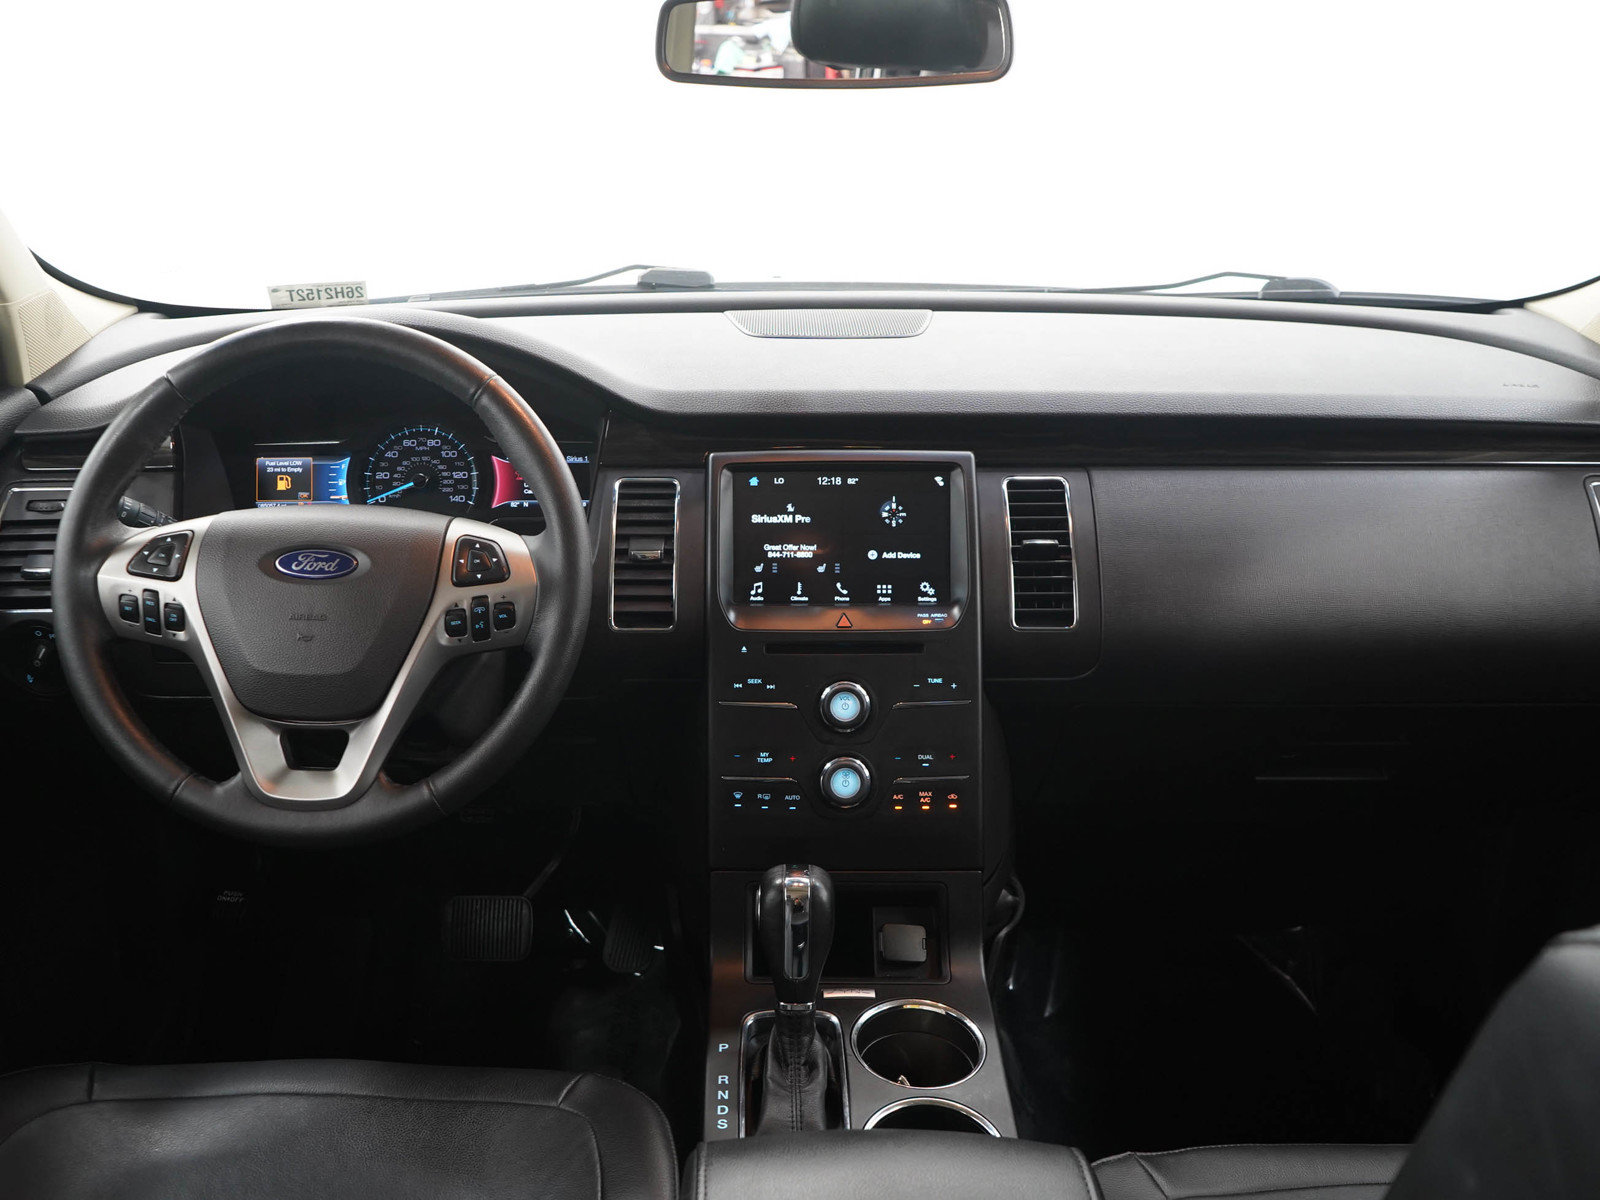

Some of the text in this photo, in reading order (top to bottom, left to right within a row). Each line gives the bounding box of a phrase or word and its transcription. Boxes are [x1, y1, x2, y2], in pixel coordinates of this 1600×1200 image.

[403, 439, 417, 447] 60
[427, 439, 441, 447] 80
[385, 450, 399, 458] 40
[441, 450, 458, 458] 100
[452, 471, 468, 479] 120
[773, 477, 785, 485] LO
[817, 476, 842, 486] 12:18
[449, 495, 466, 503] 140
[751, 514, 811, 523] SiriusXM Pre
[882, 551, 921, 559] Add Device
[291, 553, 340, 571] Ford
[718, 1043, 729, 1052] P
[718, 1075, 729, 1085] R
[717, 1090, 729, 1100] N
[717, 1105, 729, 1115] D
[716, 1119, 728, 1129] S
